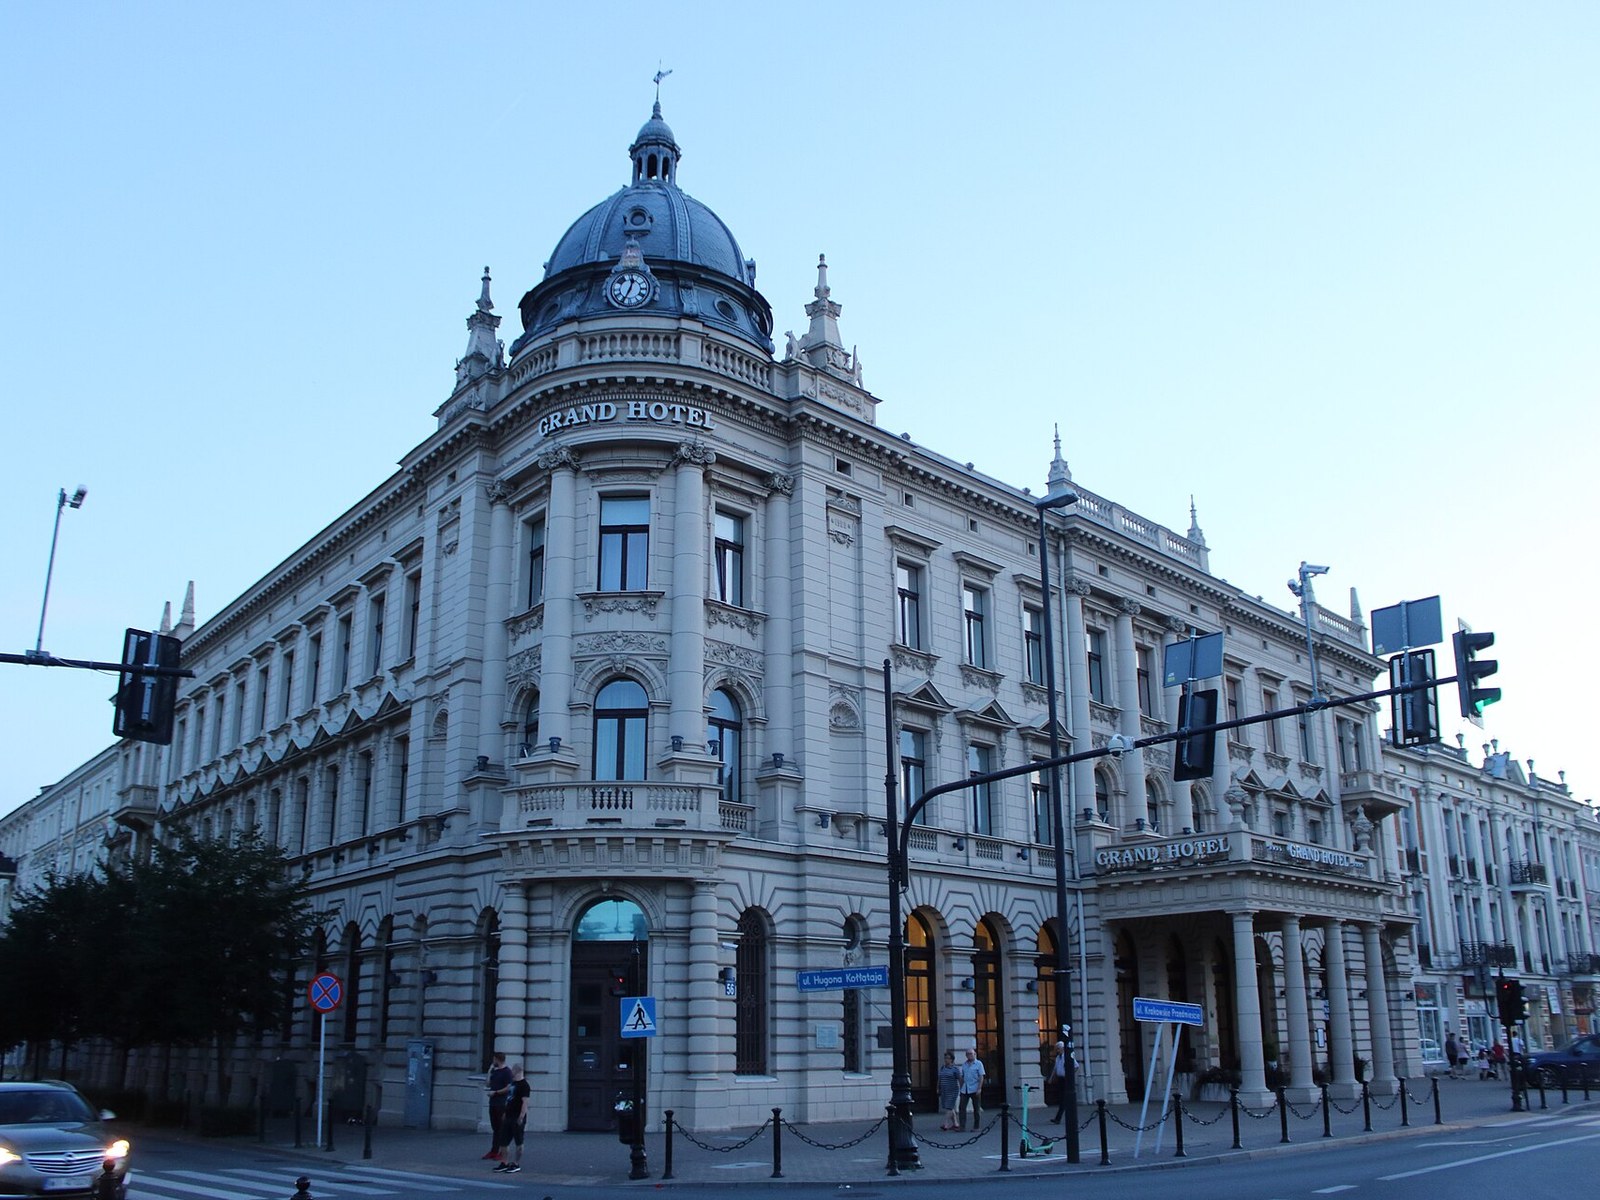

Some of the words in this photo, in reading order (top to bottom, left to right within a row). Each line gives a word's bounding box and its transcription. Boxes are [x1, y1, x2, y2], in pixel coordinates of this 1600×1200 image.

[538, 402, 616, 436] GRAND
[626, 401, 717, 430] HOTEL
[1096, 846, 1159, 867] GRAND
[1167, 837, 1231, 856] HOTEL
[1289, 844, 1320, 862] GRAND
[1323, 850, 1350, 868] HOTEL
[726, 983, 735, 995] 56
[802, 976, 811, 985] ul.
[814, 975, 843, 987] Hugona
